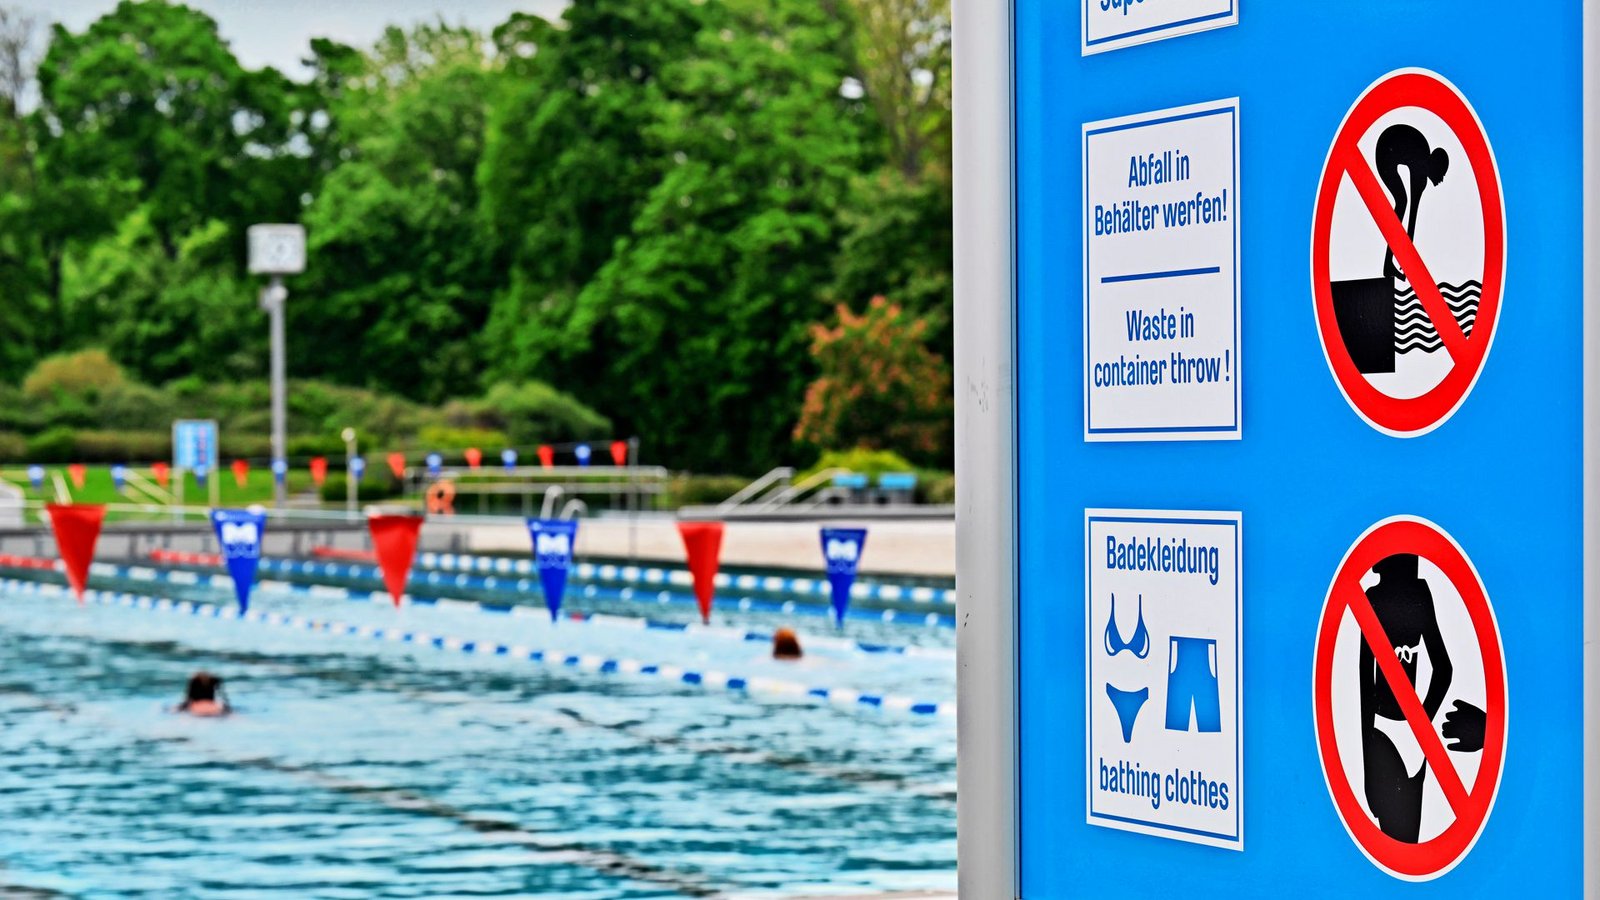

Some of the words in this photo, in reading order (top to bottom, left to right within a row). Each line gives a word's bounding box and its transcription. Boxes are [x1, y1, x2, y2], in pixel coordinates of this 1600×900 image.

[1128, 150, 1172, 188] Abfall
[1175, 149, 1190, 182] in
[1094, 200, 1161, 236] Behälter
[1163, 189, 1227, 228] werfen!
[1126, 308, 1177, 341] Waste
[1180, 306, 1194, 339] in
[1094, 354, 1168, 388] container
[1106, 535, 1219, 586] Badekleidung
[1099, 757, 1161, 810] bathing
[1165, 767, 1229, 811] clothes
